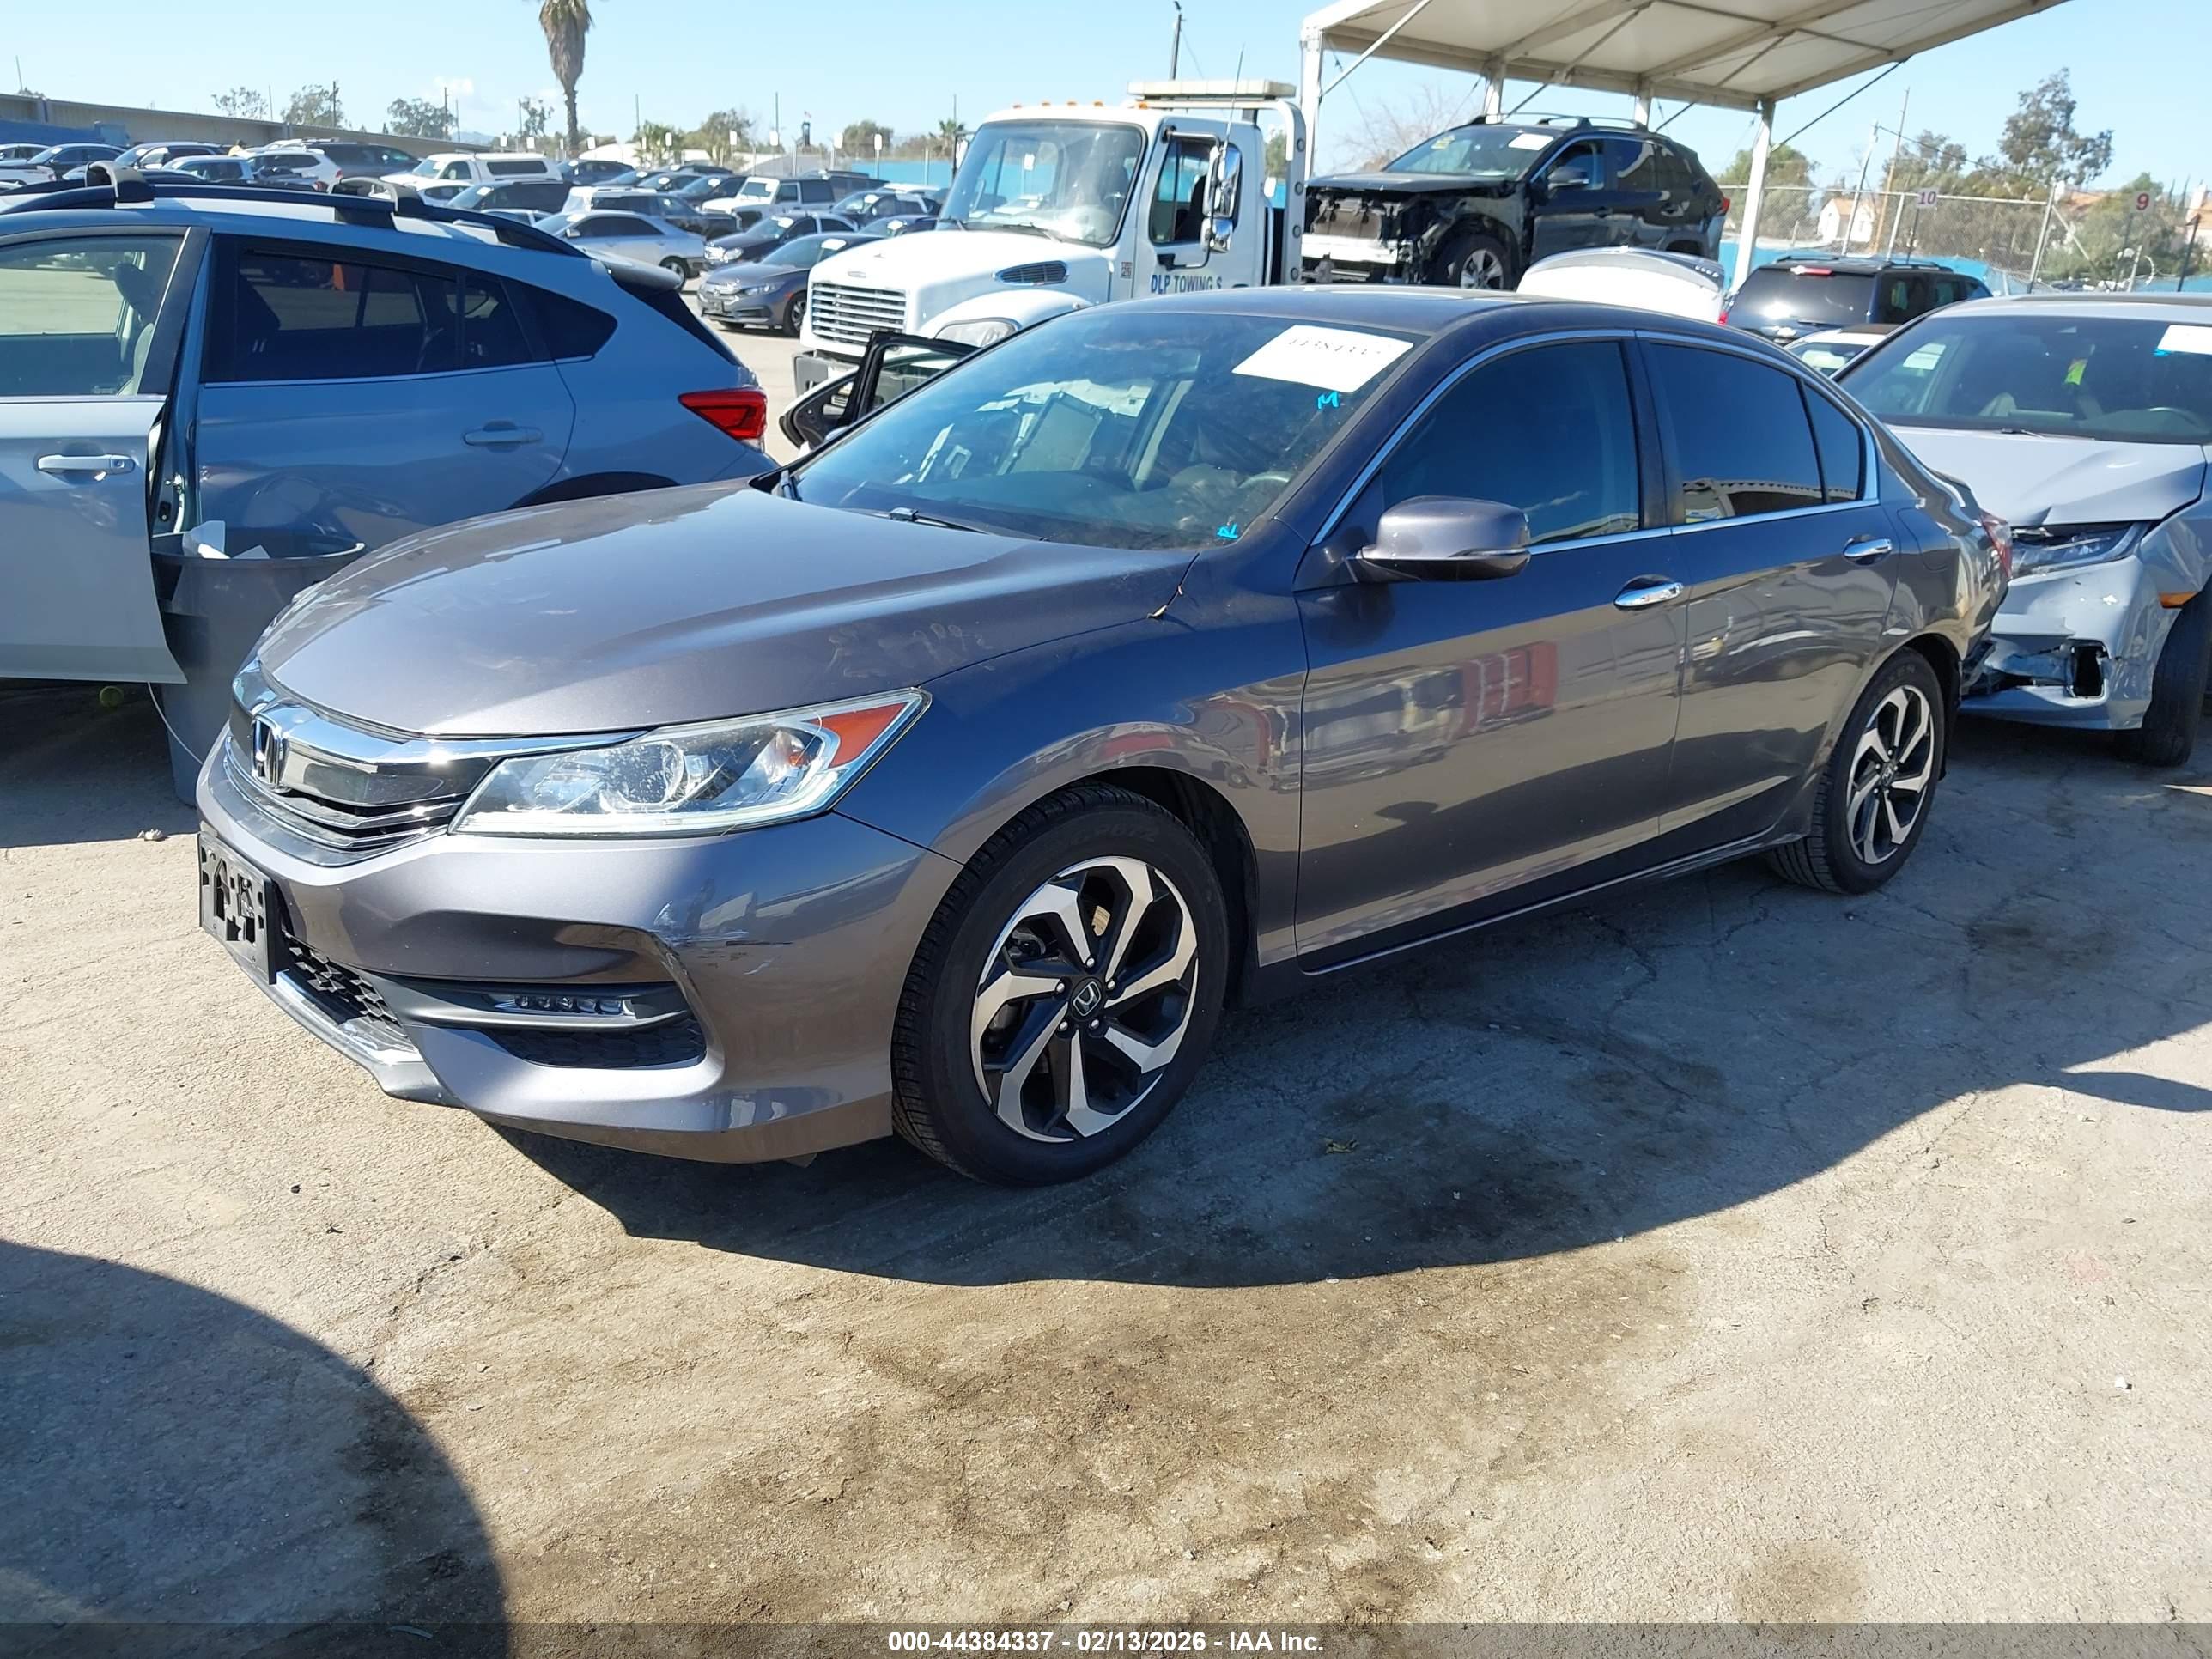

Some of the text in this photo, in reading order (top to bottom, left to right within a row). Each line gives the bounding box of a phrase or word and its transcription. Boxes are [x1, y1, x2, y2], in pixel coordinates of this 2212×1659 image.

[1917, 191, 1936, 204] 10
[2136, 192, 2149, 210] 9
[1151, 274, 1171, 295] DLP
[1173, 275, 1213, 294] TOWING
